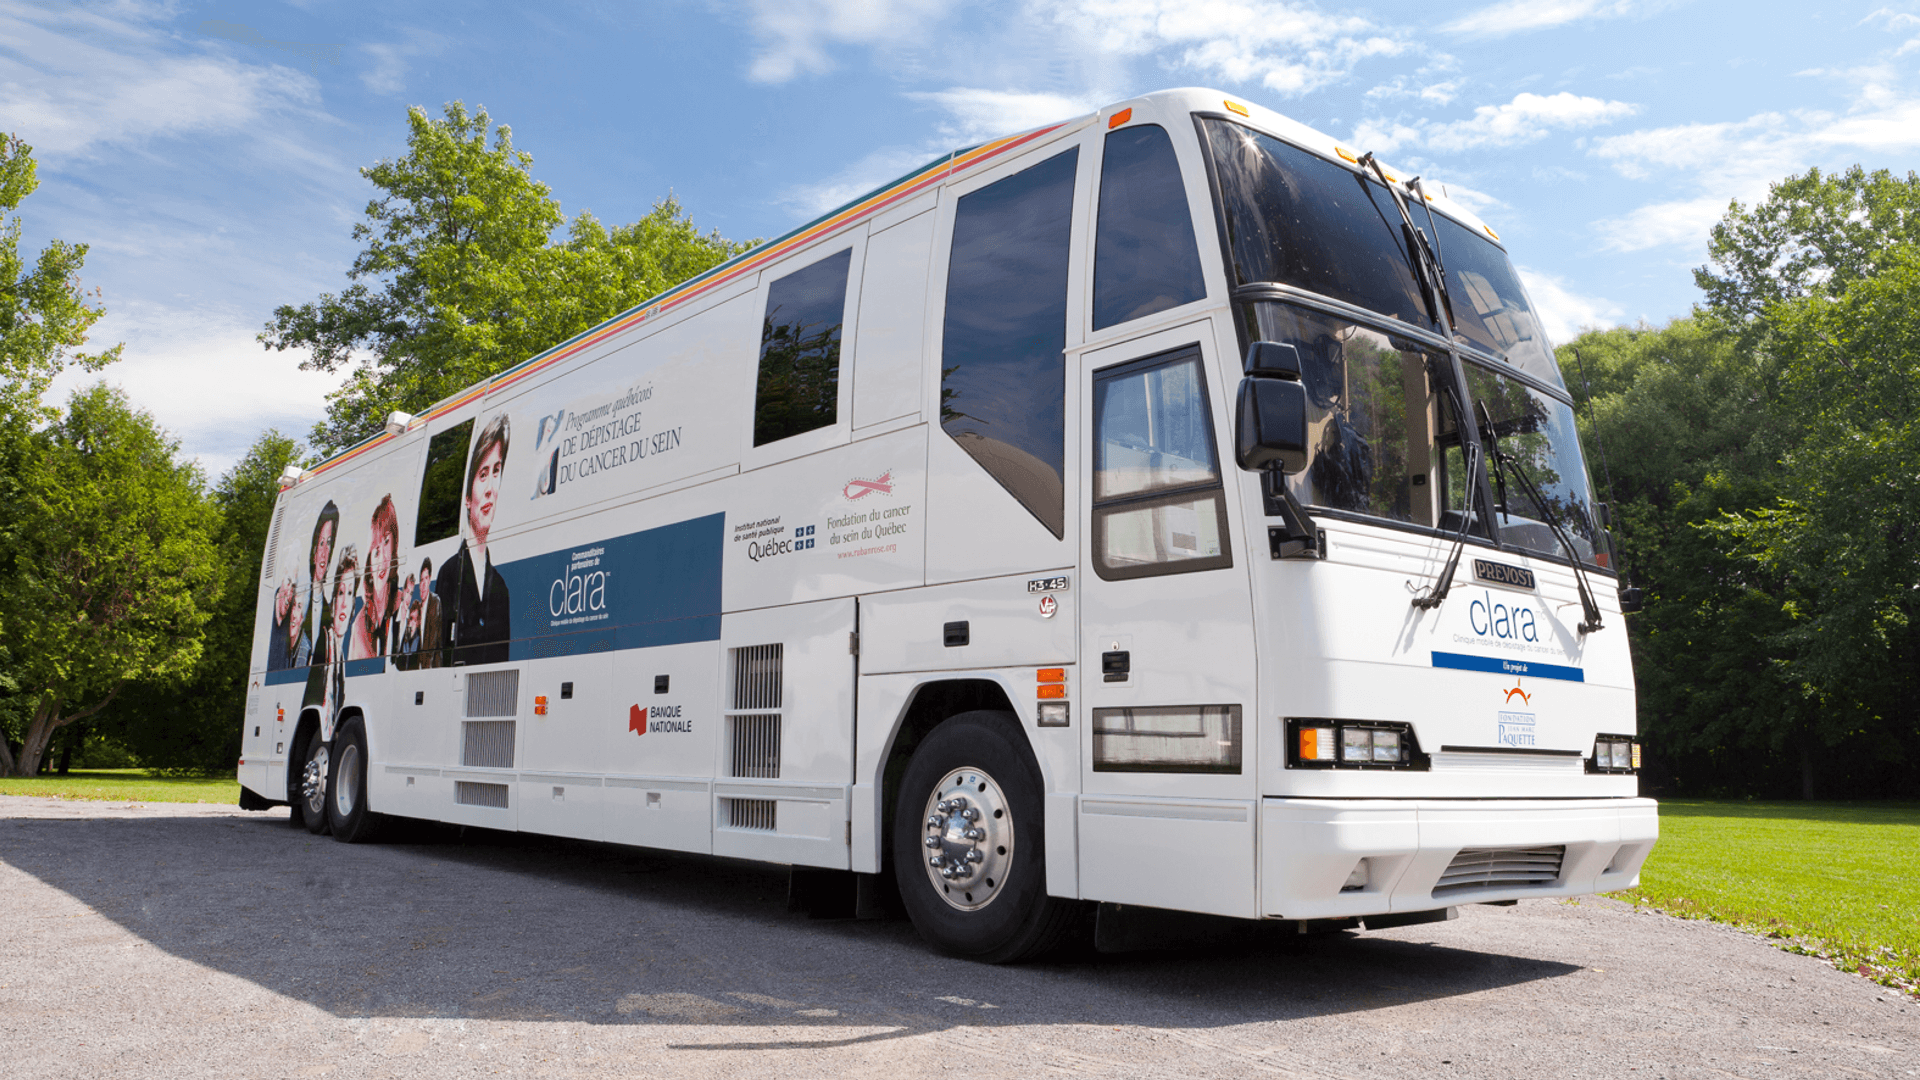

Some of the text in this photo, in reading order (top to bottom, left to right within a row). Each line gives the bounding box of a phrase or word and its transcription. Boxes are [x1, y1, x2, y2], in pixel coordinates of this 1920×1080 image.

[565, 381, 653, 431] Programme québécois
[562, 412, 642, 457] DE DÉPISTAGE
[560, 426, 682, 484] DU CANCER DU SEIN
[734, 515, 781, 533] Institut national
[827, 505, 911, 529] Fondation du cancer
[734, 525, 785, 542] de santé publique
[830, 521, 907, 545] du sein du Québec
[748, 537, 793, 562] Québec
[1477, 560, 1533, 588] PREVOST
[550, 565, 606, 617] clara
[1469, 590, 1539, 643] clara
[650, 705, 682, 718] BANQUE
[649, 720, 692, 733] NATIONALE
[1498, 724, 1535, 747] PAQUETTE
